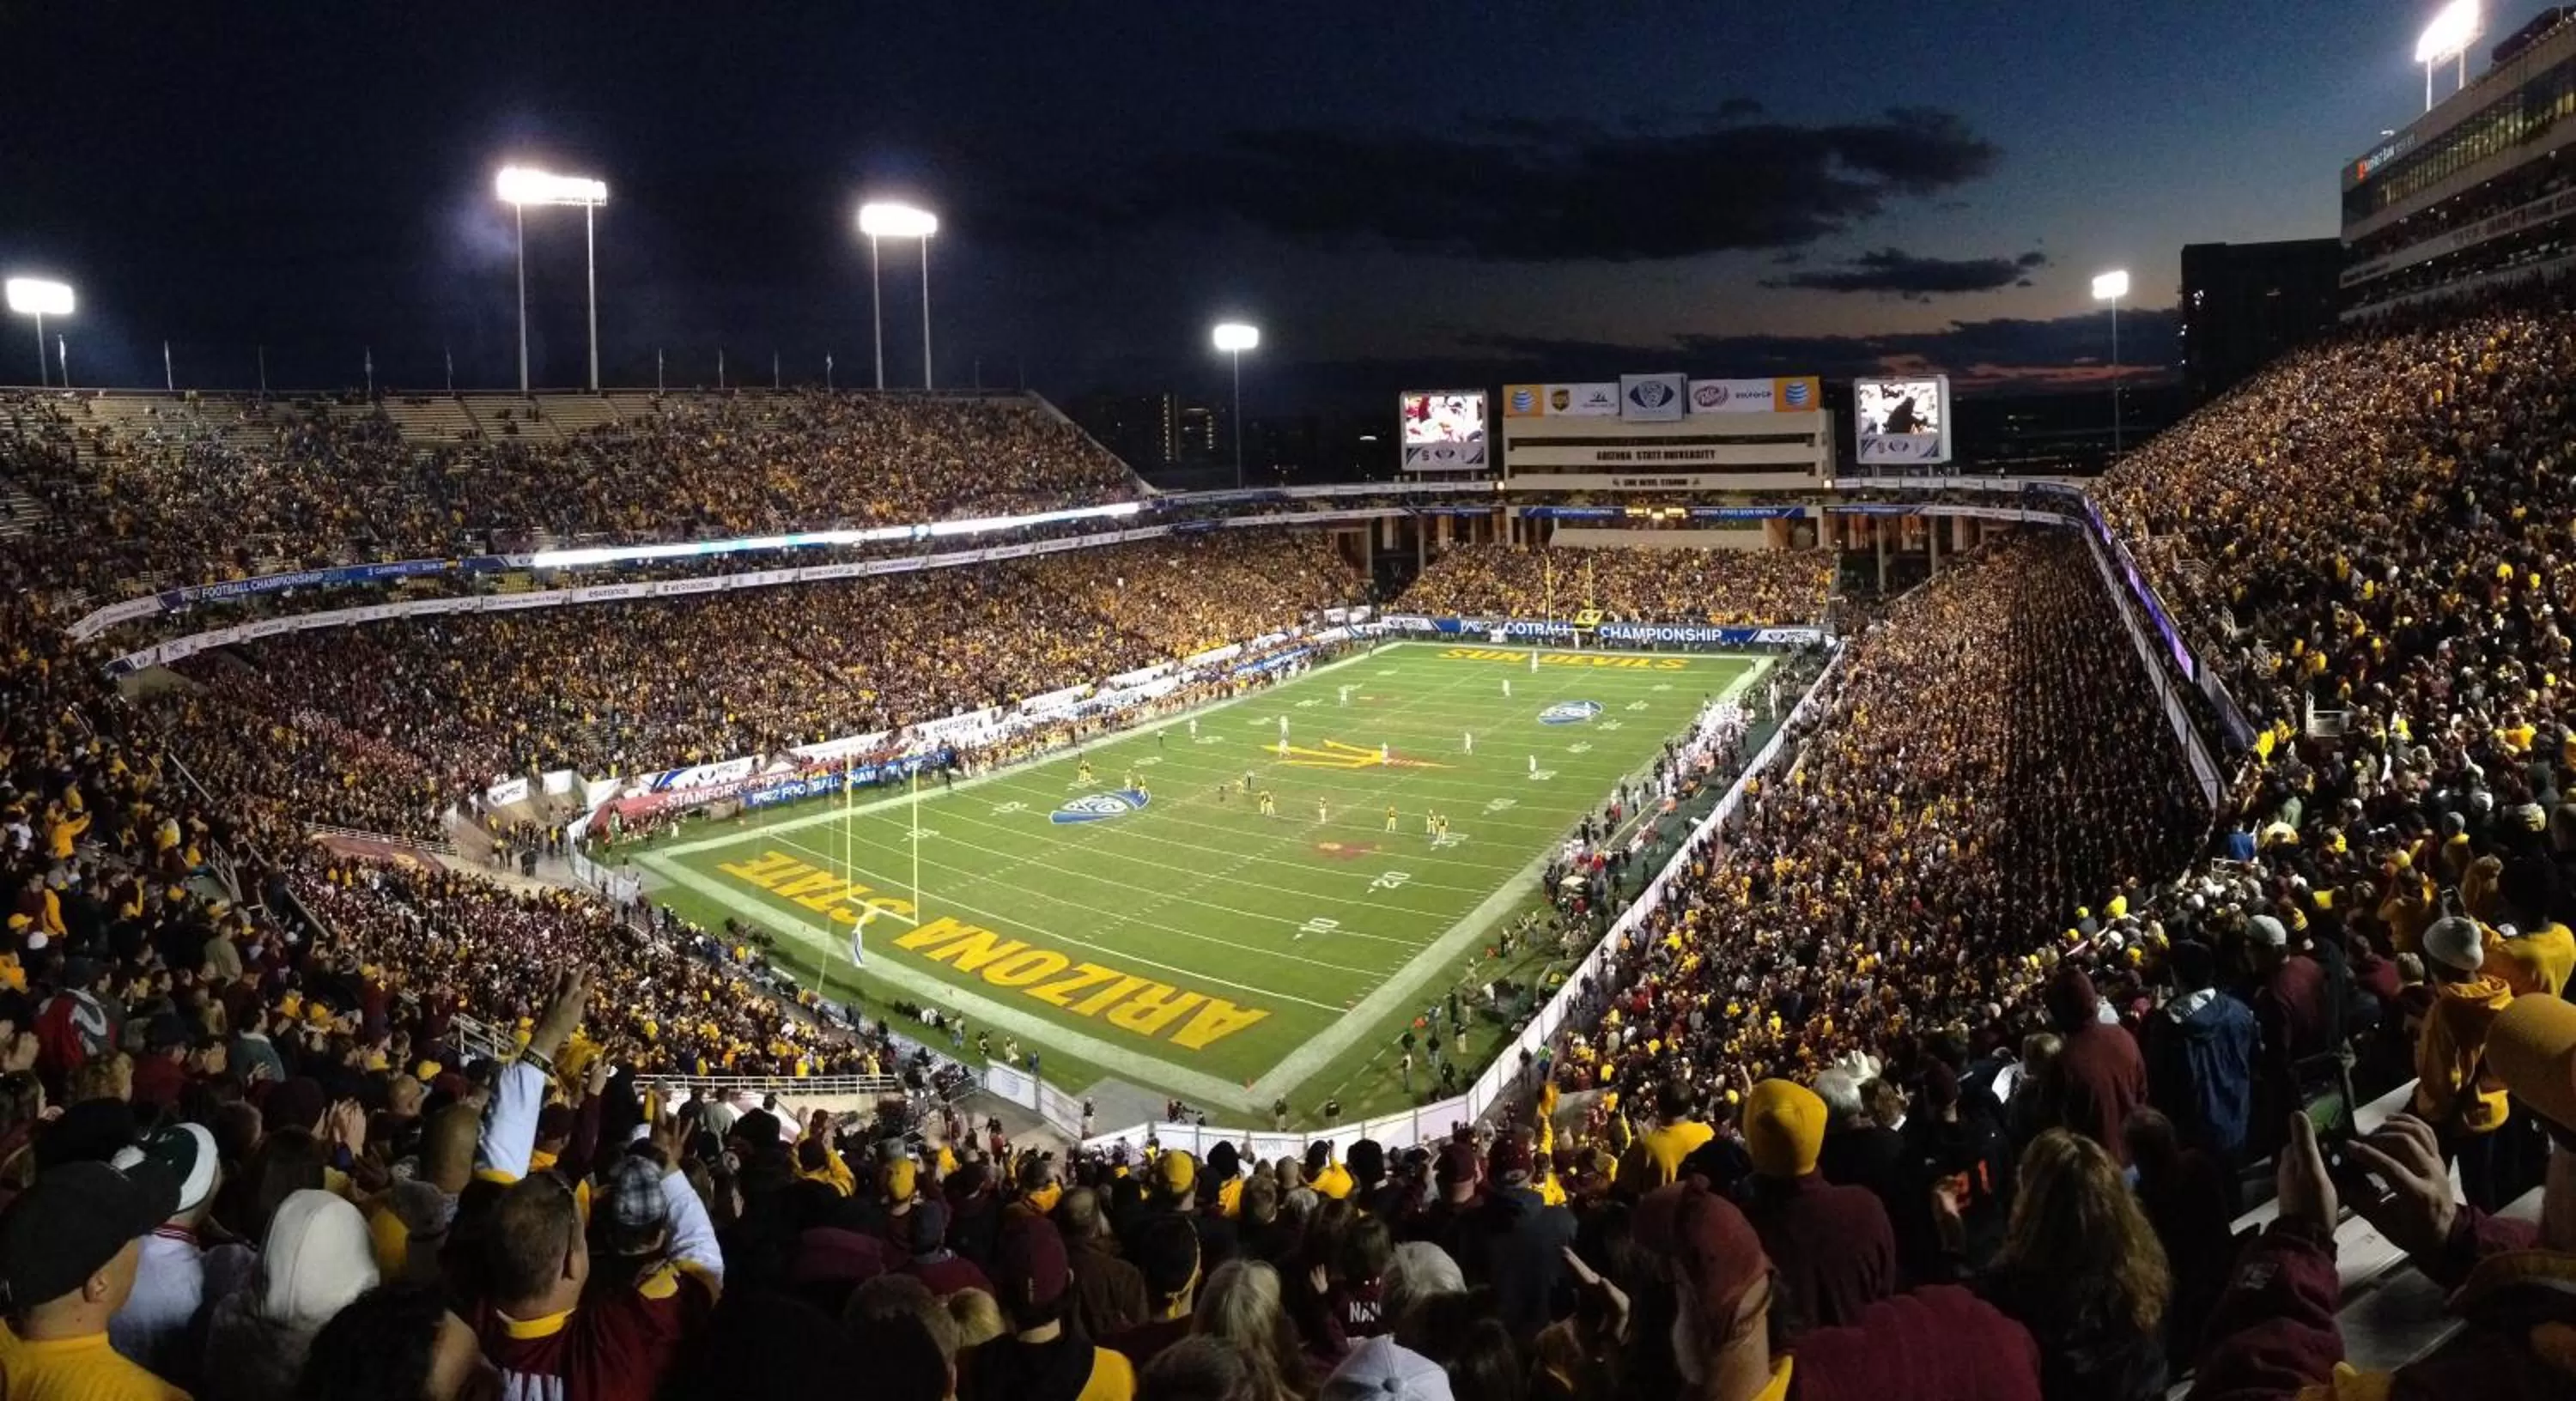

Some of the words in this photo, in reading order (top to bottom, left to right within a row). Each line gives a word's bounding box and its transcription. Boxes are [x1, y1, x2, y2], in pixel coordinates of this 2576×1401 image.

[1636, 451, 1662, 461] STATE
[1664, 449, 1716, 460] UNIVERSITY
[202, 582, 250, 598] FOOTBALL
[250, 571, 324, 591] CHAMPIONSHIP
[1600, 626, 1723, 642] CHAMPIONSHIP
[1438, 648, 1529, 663] SUN
[1540, 653, 1691, 669] DEVILS
[715, 850, 915, 926] STATE
[892, 916, 1273, 1051] ARIZONA
